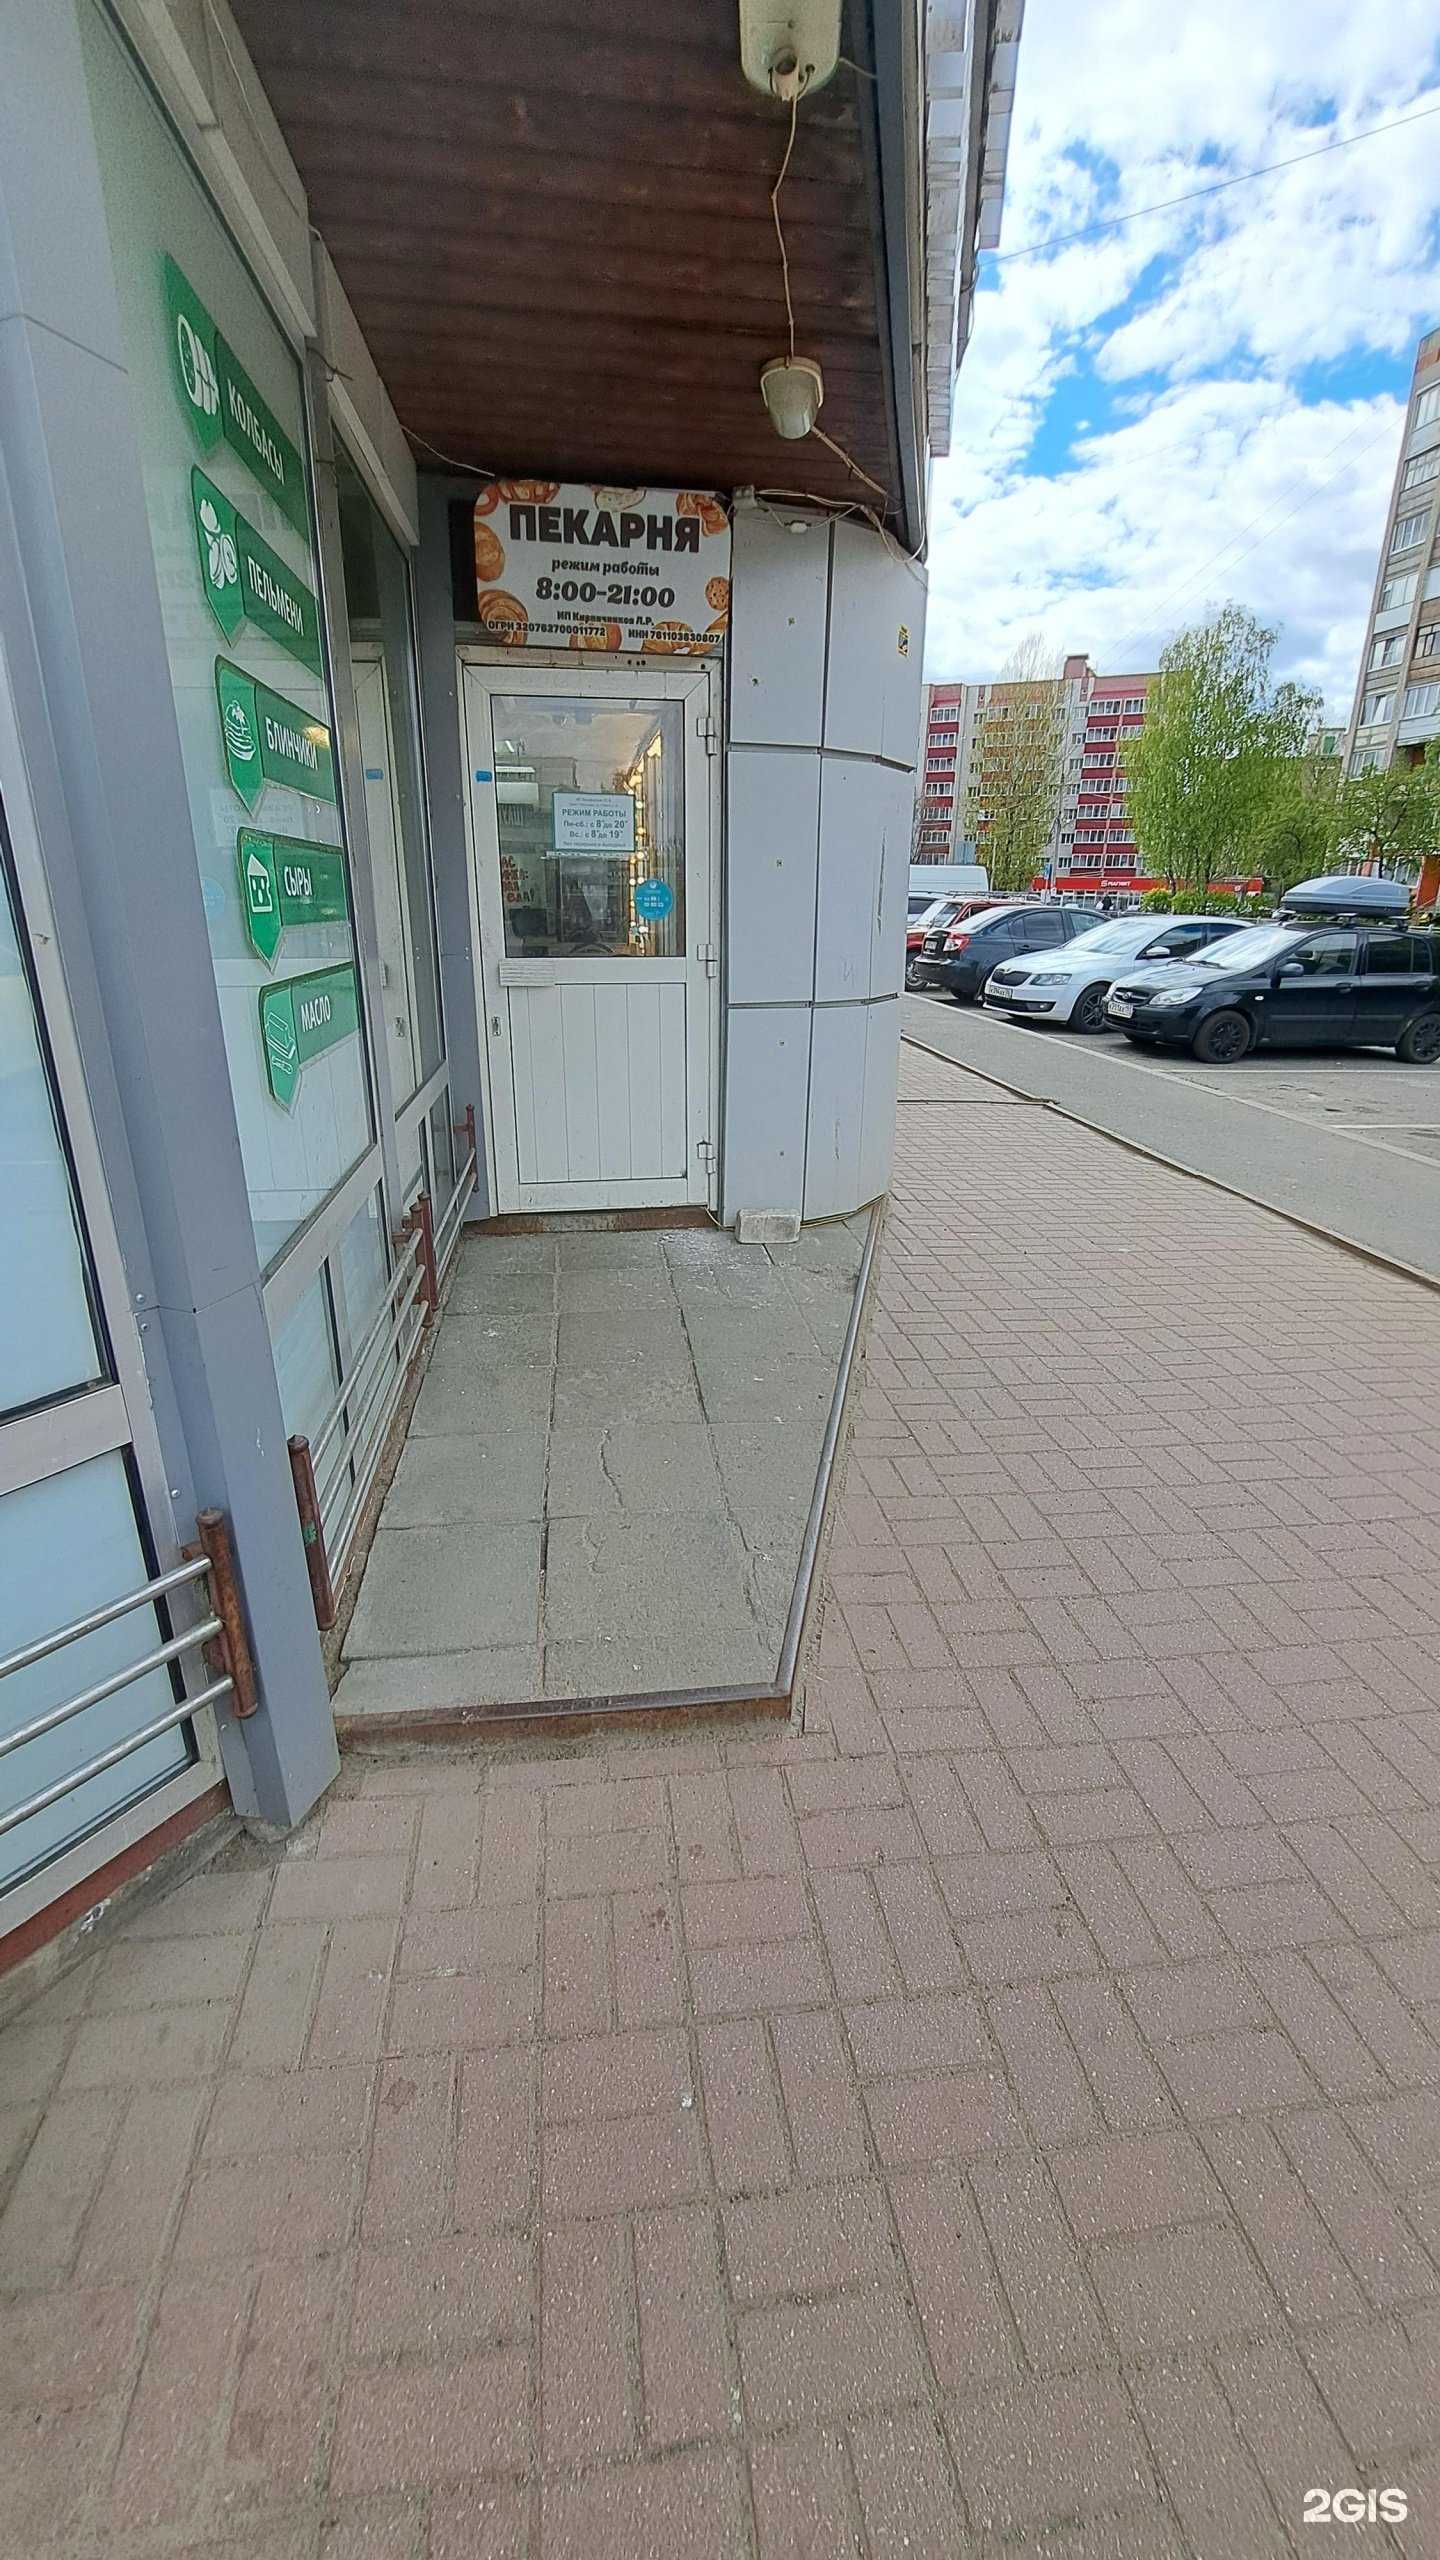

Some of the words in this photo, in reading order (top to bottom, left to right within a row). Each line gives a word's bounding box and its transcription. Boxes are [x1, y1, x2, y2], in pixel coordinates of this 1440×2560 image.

[227, 377, 285, 486] КОЛБАСЫ
[508, 504, 701, 553] ПЕКАРНЯ
[551, 558, 600, 573] режим
[603, 559, 660, 576] работы
[247, 555, 304, 636] ПЕЛЬМЕНИ
[535, 577, 676, 608] 8:00-21:00
[488, 620, 514, 631] ОГРН
[557, 611, 571, 621] ИП
[628, 629, 649, 640] ИНН
[264, 716, 318, 771] БЛИНЧИКИ
[561, 808, 591, 817] РЕЖИМ
[593, 809, 627, 818] РАБОТЫ
[284, 864, 313, 897] СЫРЫ
[301, 994, 332, 1032] МАСЛО
